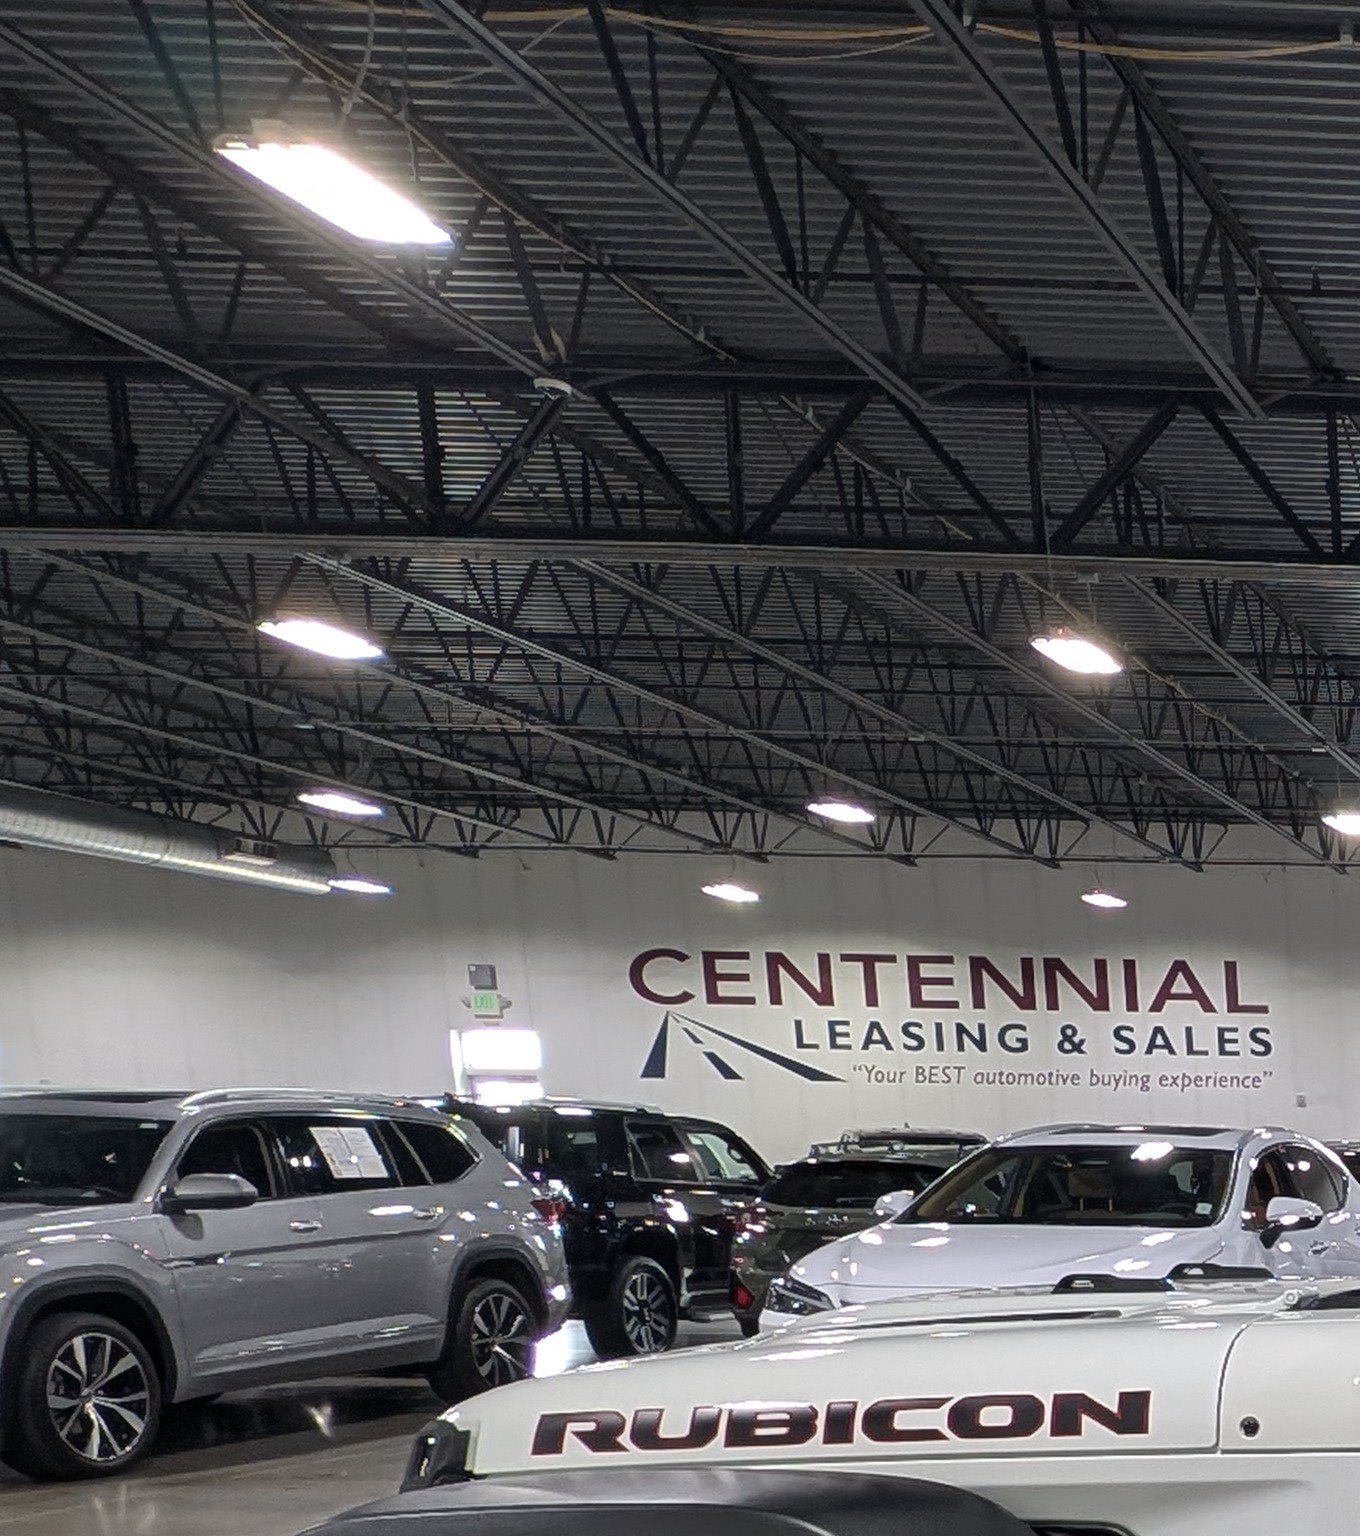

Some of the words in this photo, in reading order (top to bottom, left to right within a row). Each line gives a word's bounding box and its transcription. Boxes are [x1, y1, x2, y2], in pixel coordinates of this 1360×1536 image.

[628, 948, 1270, 1015] CENTENNIAL
[793, 1019, 1030, 1054] LEASING
[1057, 1024, 1088, 1055] &
[1112, 1024, 1273, 1057] SALES
[914, 1066, 966, 1085] BEST
[973, 1069, 1081, 1087] automotive
[1089, 1068, 1151, 1092] buying
[531, 1390, 1152, 1456] RUBICON
